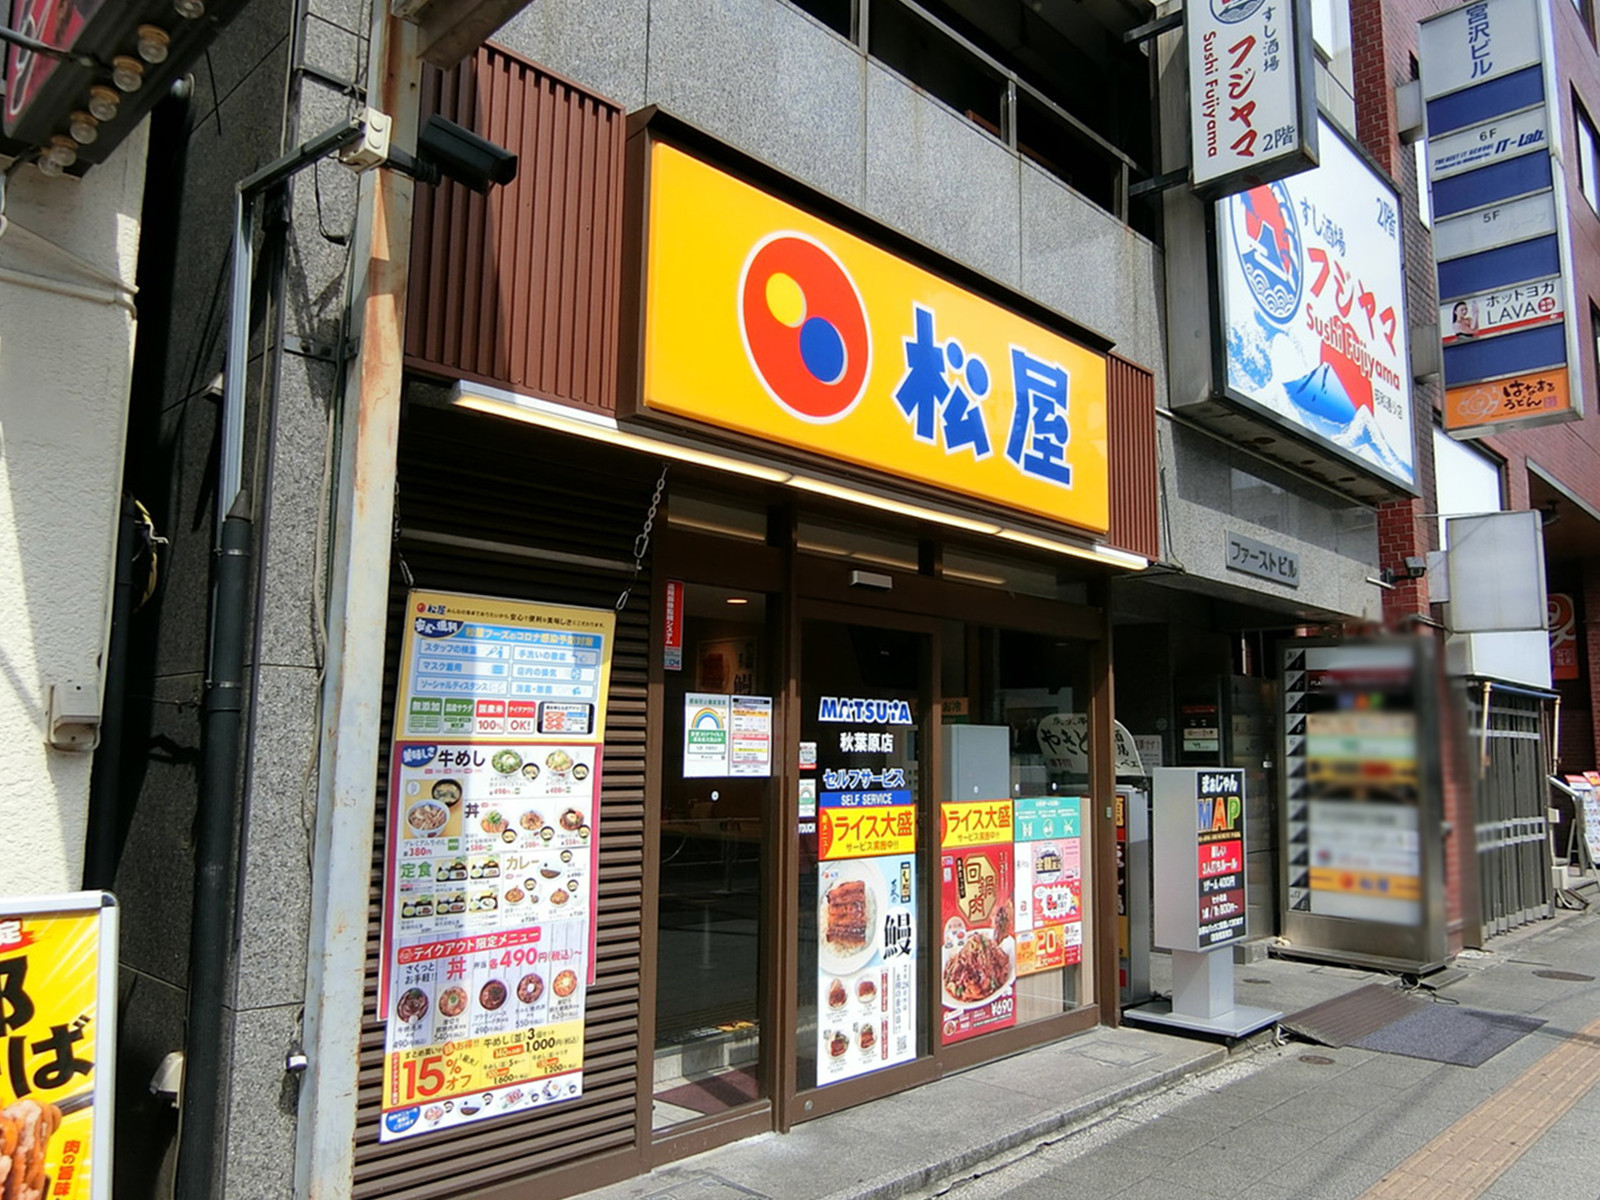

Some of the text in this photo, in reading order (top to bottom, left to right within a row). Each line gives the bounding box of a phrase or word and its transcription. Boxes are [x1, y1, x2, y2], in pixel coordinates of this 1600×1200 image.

[1262, 6, 1280, 73] すし酒場
[1466, 2, 1493, 79] 宮沢ビル
[1202, 31, 1220, 158] Sushi Fujiyama
[1228, 35, 1258, 157] フジヤマ
[1262, 124, 1295, 152] 2階
[1479, 127, 1497, 142] 6F
[1300, 196, 1346, 257] すし酒場
[1375, 197, 1397, 239] 2階
[1483, 210, 1501, 224] 5F
[1307, 246, 1398, 357] フジヤマ
[1486, 280, 1556, 309] ホットヨガ
[1488, 302, 1538, 325] LAVA
[1306, 303, 1400, 391] Sushi Fujiyama
[890, 301, 1074, 491] 松屋
[1503, 380, 1556, 399] はなまる
[1504, 396, 1542, 411] うどん
[1230, 541, 1297, 579] ファーストビル
[510, 720, 531, 731] OK!
[839, 732, 894, 753] 秋葉原店
[1040, 728, 1088, 755] やきと
[438, 749, 486, 768] 牛めし
[823, 768, 906, 790] セルフサービス
[1202, 774, 1239, 794] まぁじゃん
[464, 803, 480, 819] 丼
[841, 793, 893, 806] SELF SERVICE
[835, 811, 913, 842] ライス大盛
[948, 805, 1011, 833] ライス大盛
[1197, 796, 1241, 833] MAP
[846, 840, 900, 852] サービス実施中!!
[400, 861, 432, 879] 定食
[506, 856, 540, 871] カレー
[965, 862, 997, 919] 回鍋肉
[413, 932, 540, 959] テイクアウト限定メニュー
[883, 913, 911, 960] 鰻
[406, 963, 436, 974] さくっと
[446, 956, 467, 980] 丼
[991, 998, 1014, 1016] ¥690
[8, 1014, 96, 1098] ば
[402, 1055, 462, 1100] 15%
[445, 1074, 472, 1091] オフ
